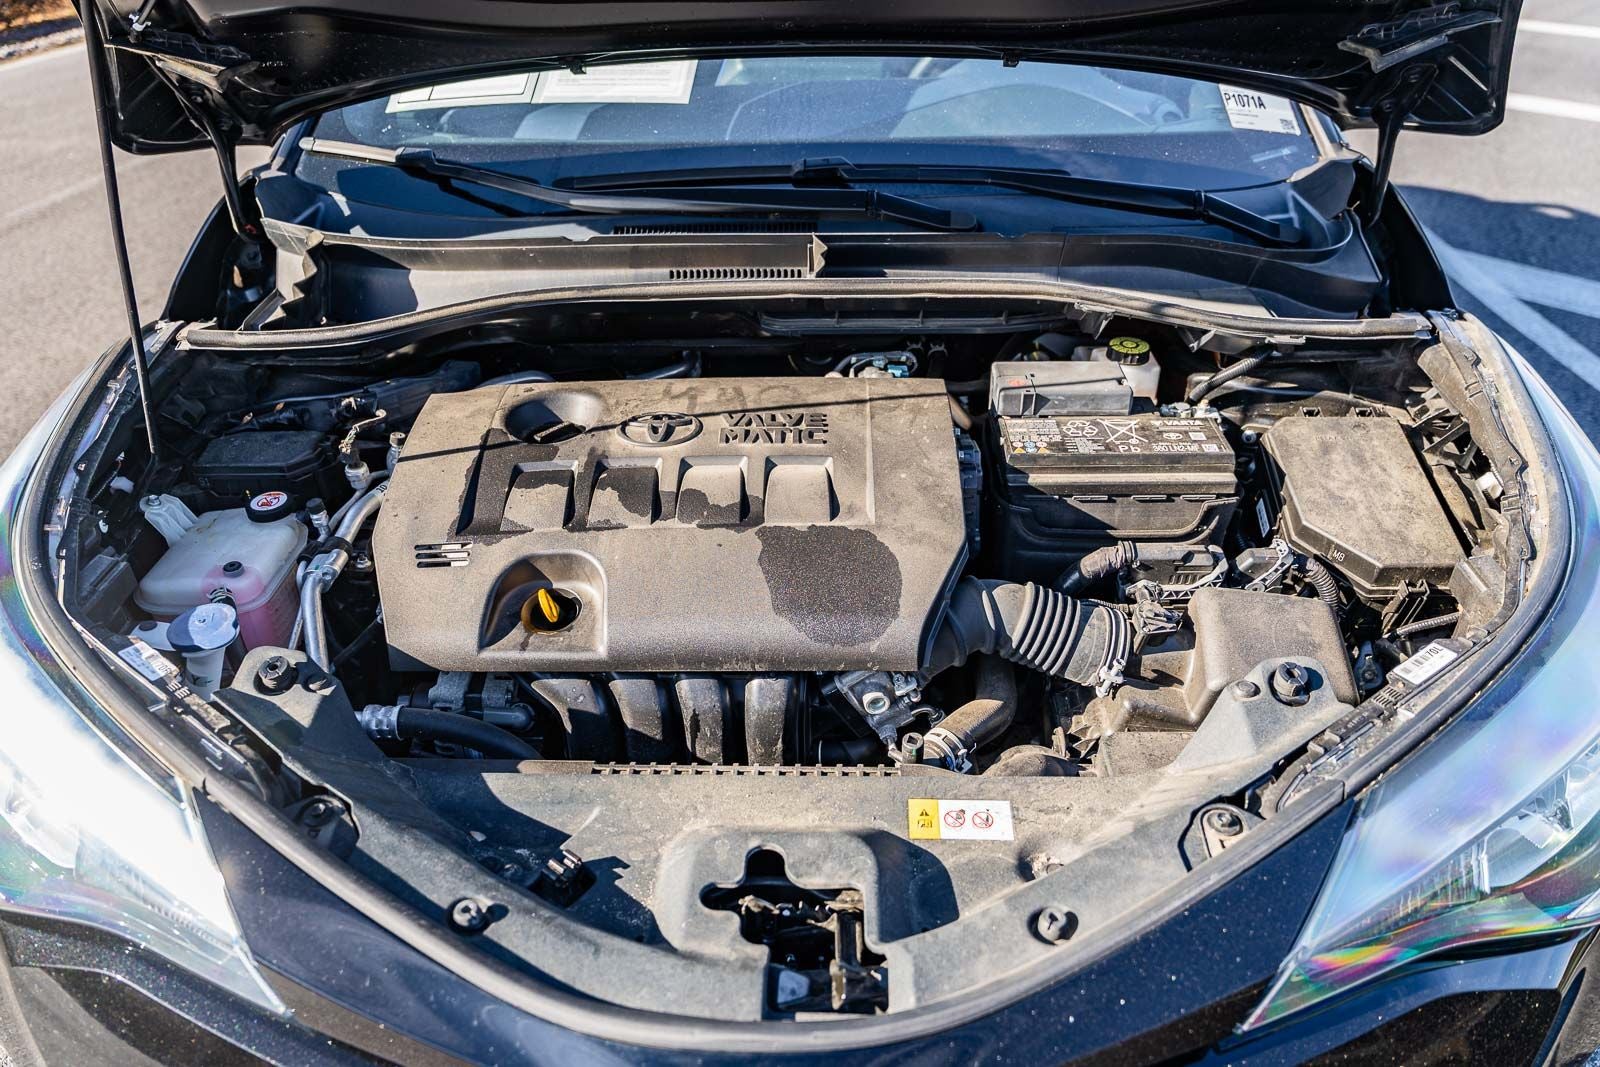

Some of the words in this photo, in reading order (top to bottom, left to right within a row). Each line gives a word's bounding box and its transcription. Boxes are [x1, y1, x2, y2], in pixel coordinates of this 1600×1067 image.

[1224, 92, 1266, 109] P1071A
[720, 412, 828, 427] VALVE
[719, 427, 829, 445] MATIC
[1118, 445, 1141, 453] Pb
